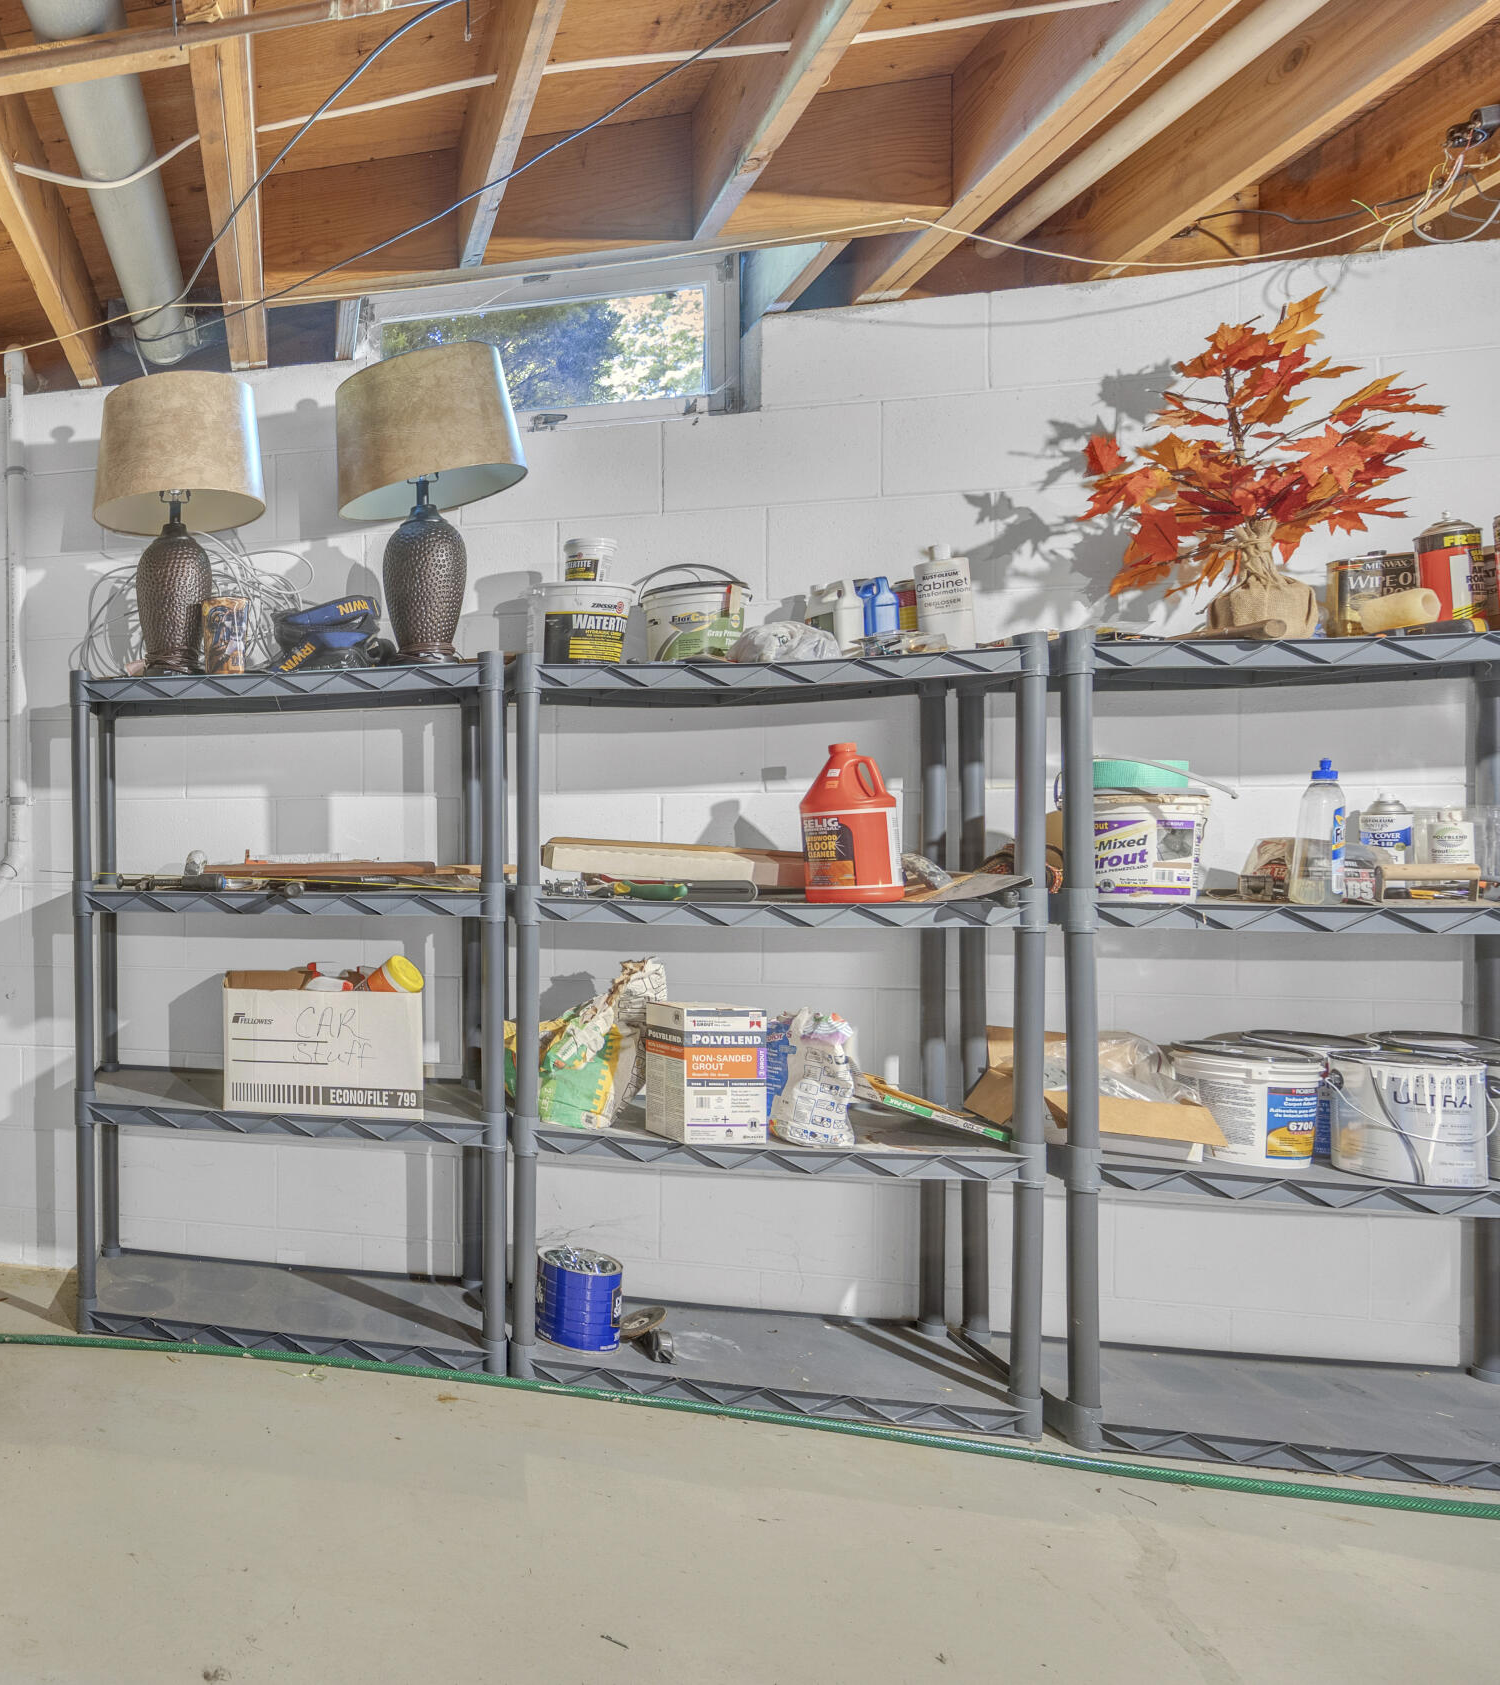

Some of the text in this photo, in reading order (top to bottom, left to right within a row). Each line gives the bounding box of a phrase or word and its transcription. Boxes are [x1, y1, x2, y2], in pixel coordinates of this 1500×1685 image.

[1365, 560, 1409, 570] MINWAX
[916, 577, 968, 593] Cabinet
[591, 602, 618, 610] ZINSSER
[279, 642, 316, 672] IRWIN
[803, 817, 839, 828] SELIG
[807, 841, 836, 851] FLOOR
[296, 1006, 371, 1041] CAR
[648, 1029, 683, 1044] POLYBLEND
[691, 1034, 763, 1046] POLYBLEND
[293, 1040, 375, 1069] Stuff
[691, 1054, 753, 1063] NON-SANDED
[691, 1063, 724, 1071] GROUT
[397, 1092, 417, 1106] 799
[1393, 1090, 1473, 1108] ULTRA
[1289, 1121, 1314, 1132] 6700
